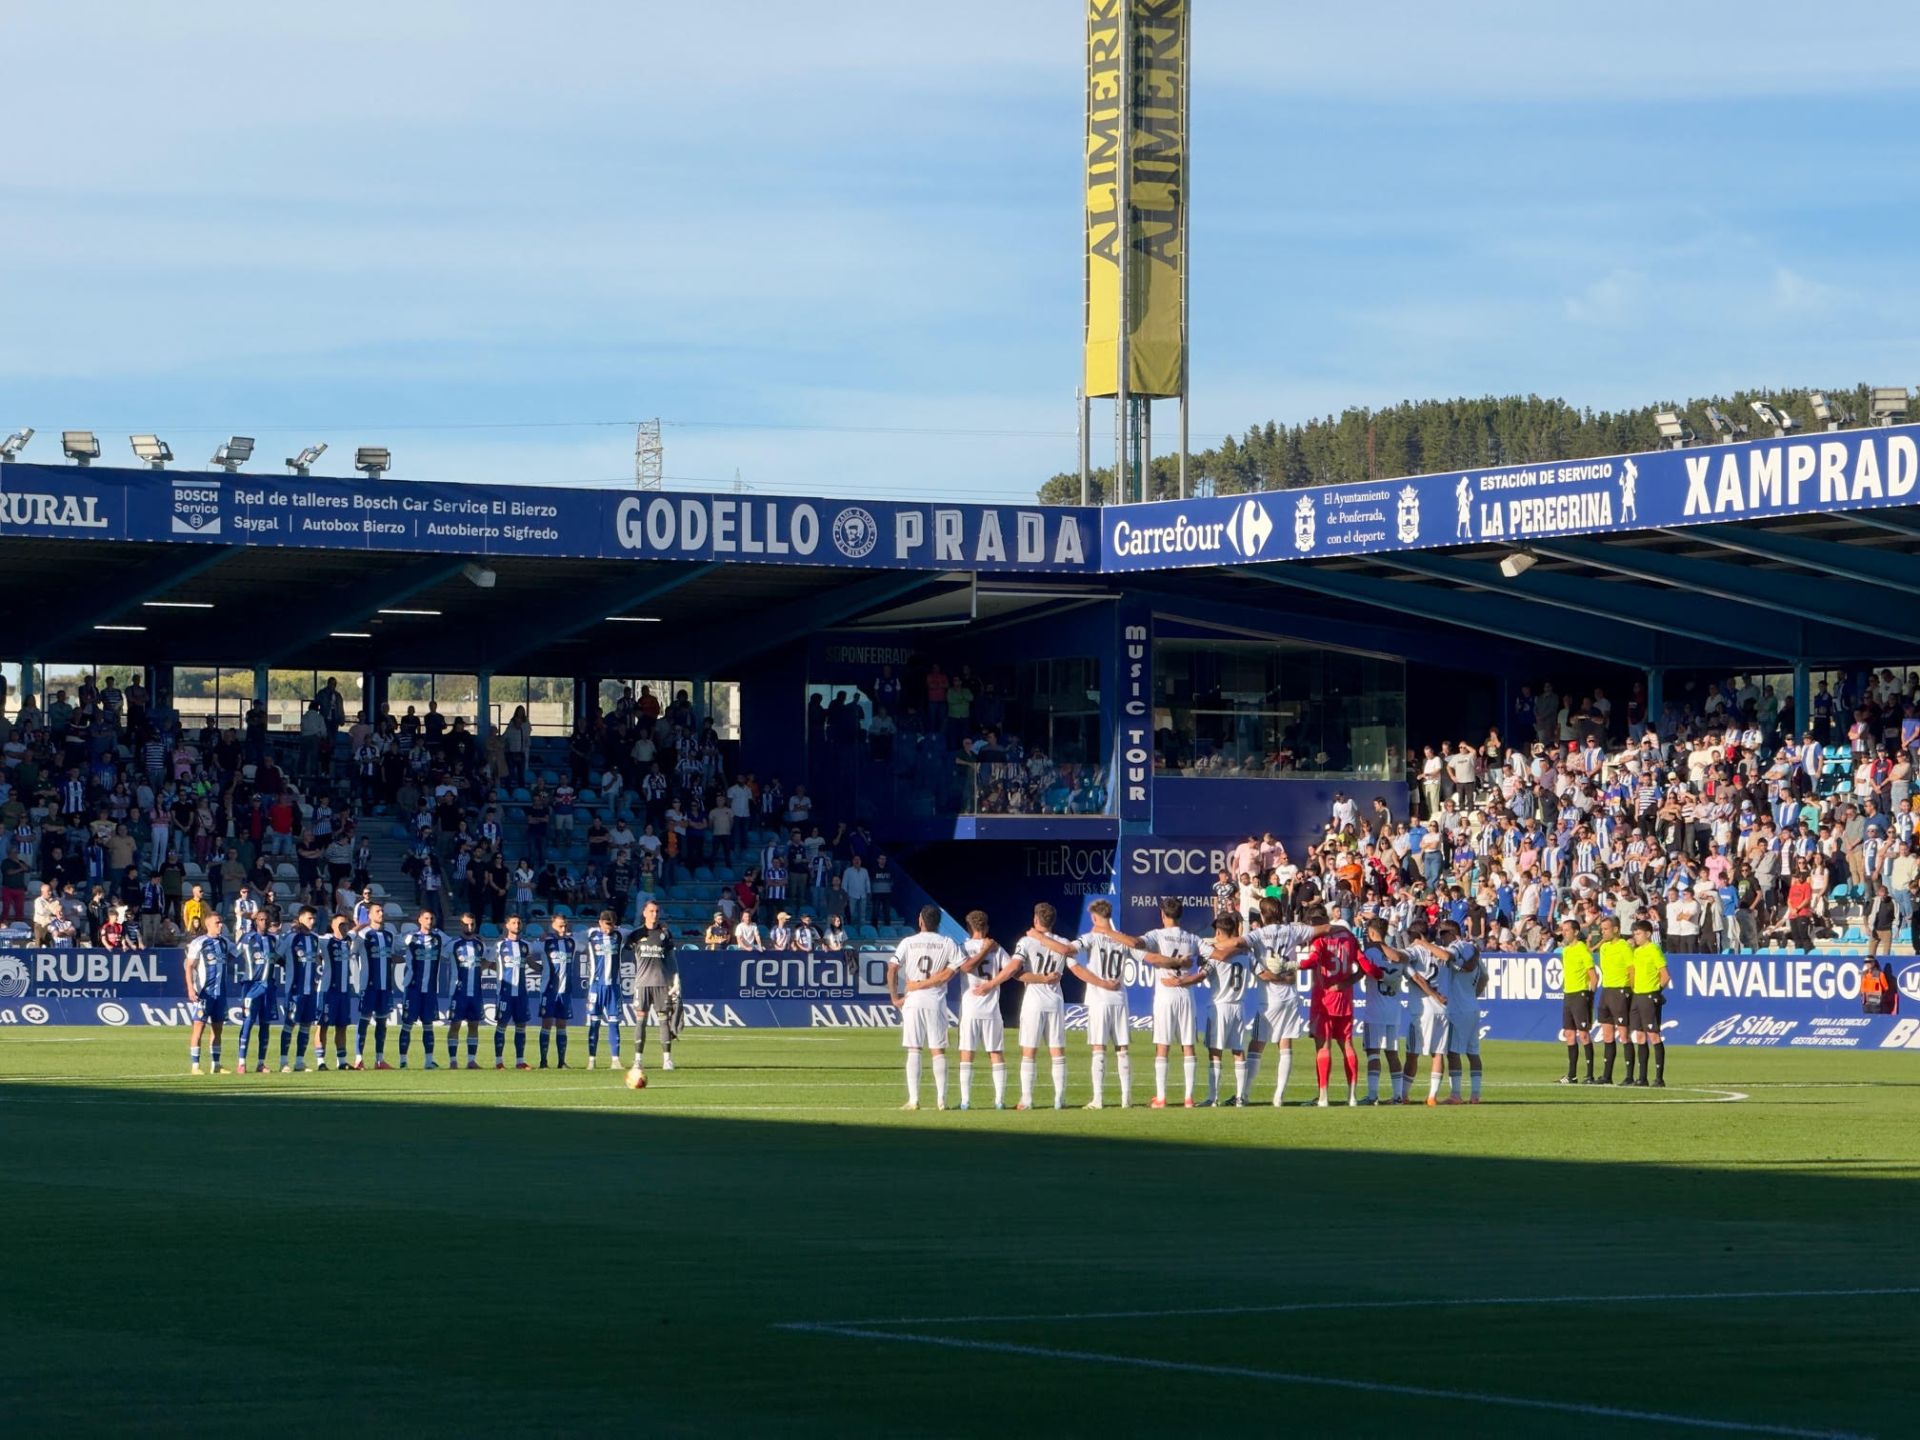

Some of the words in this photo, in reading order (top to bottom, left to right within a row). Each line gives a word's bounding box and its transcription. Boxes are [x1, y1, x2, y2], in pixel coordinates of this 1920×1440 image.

[1480, 469, 1537, 491] ESTACIÓN
[1539, 469, 1555, 485] DE
[1558, 463, 1612, 483] SERVICIO
[1684, 436, 1918, 515] XAMPRAD
[174, 489, 218, 502] BOSCH
[234, 490, 264, 505] Red
[269, 491, 288, 506] de
[292, 492, 349, 509] talleres
[353, 494, 398, 511] Bosch
[402, 496, 428, 512] Car
[433, 498, 488, 515] Service
[492, 500, 507, 515] El
[511, 501, 558, 518] Bierzo
[1323, 492, 1333, 505] El
[1334, 489, 1391, 507] Ayuntamiento
[174, 502, 219, 514] Service
[1327, 512, 1337, 525] de
[1339, 509, 1386, 524] Ponferrada,
[1480, 502, 1504, 537] LA
[1509, 491, 1612, 533] PEREGRINA
[234, 515, 279, 533] Saygal
[302, 517, 359, 534] Autobox
[363, 520, 406, 535] Bierzo
[427, 522, 499, 538] Autobierzo
[503, 525, 558, 542] Sigfredo
[616, 497, 819, 555] GODELLO
[895, 510, 1085, 564] PRADA
[1113, 515, 1224, 557] Carrefour
[1327, 534, 1342, 545] con
[1343, 531, 1352, 544] el
[1353, 530, 1386, 545] deporte
[1125, 625, 1147, 716] MUSIC
[1125, 729, 1148, 801] TOUR
[1131, 895, 1159, 907] PARA
[36, 954, 168, 983] RUBIAL
[917, 955, 933, 979] 9
[1100, 948, 1123, 979] 10
[1477, 958, 1543, 1000] FINO
[739, 986, 855, 998] elevaciones
[1735, 1015, 1799, 1036] Siber
